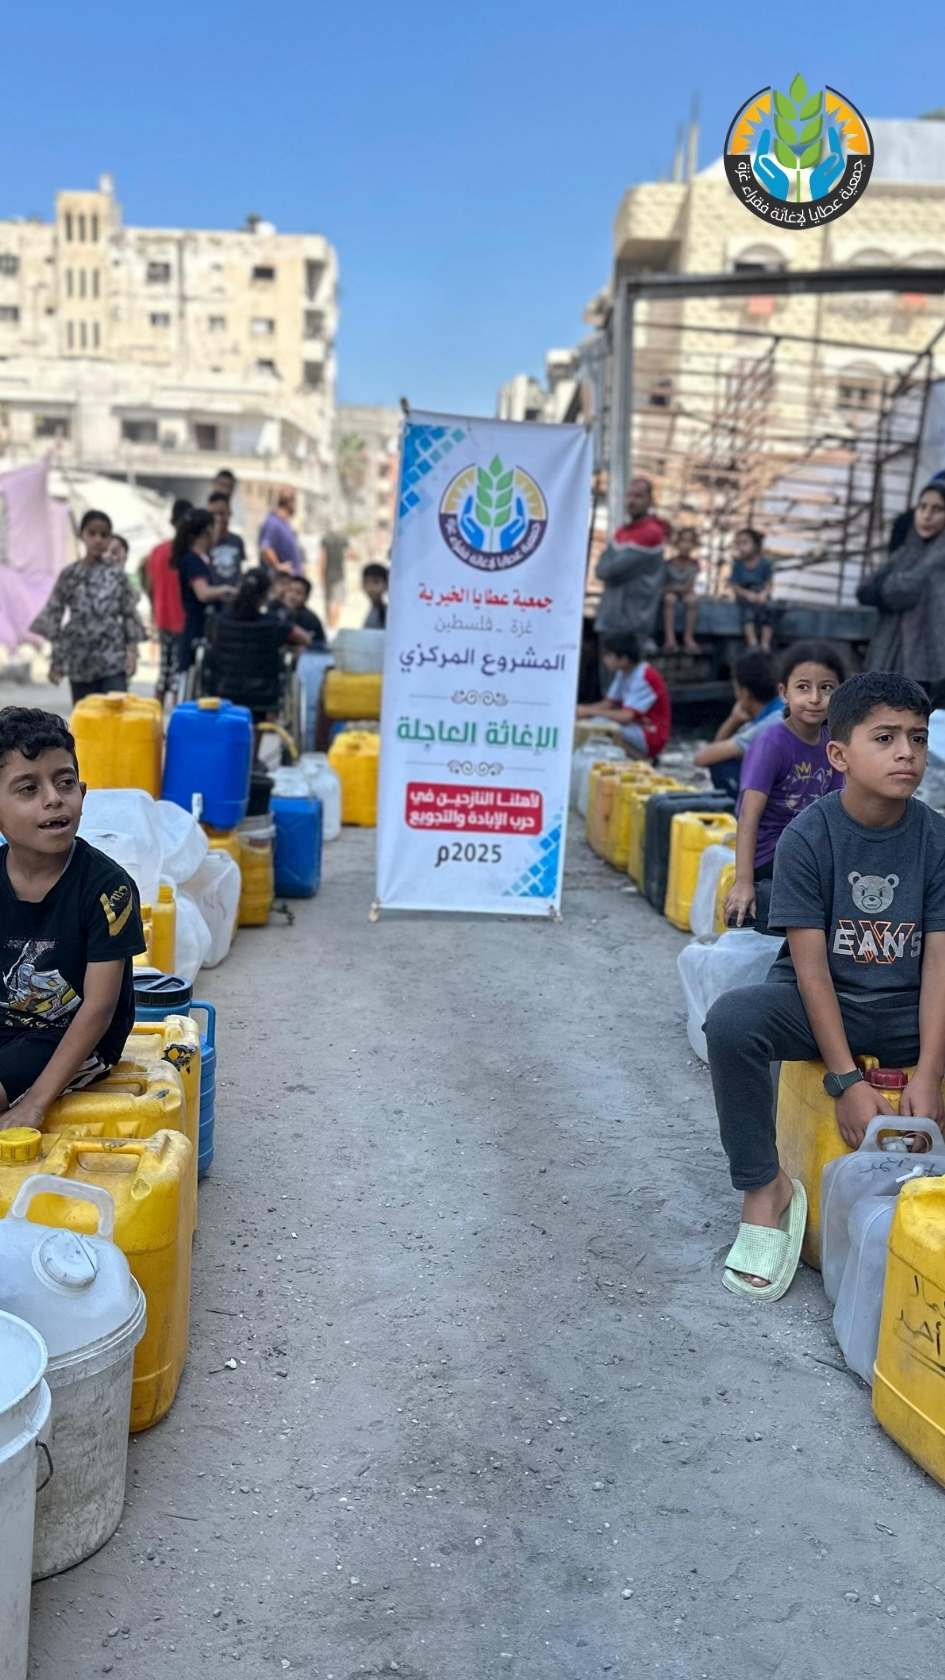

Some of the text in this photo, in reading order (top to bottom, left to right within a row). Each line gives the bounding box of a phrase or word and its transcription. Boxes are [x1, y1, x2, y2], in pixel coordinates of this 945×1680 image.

[418, 583, 553, 613] جمعية عطايا الخيرية
[434, 614, 493, 634] فلسطين
[510, 619, 534, 638] غزة
[399, 643, 566, 676] المشروع المركزي
[396, 716, 560, 756] الإغاثة العاجلة
[410, 788, 435, 805] في
[436, 790, 494, 808] النازحين
[408, 810, 536, 831] حرب الإبادة والتجويع
